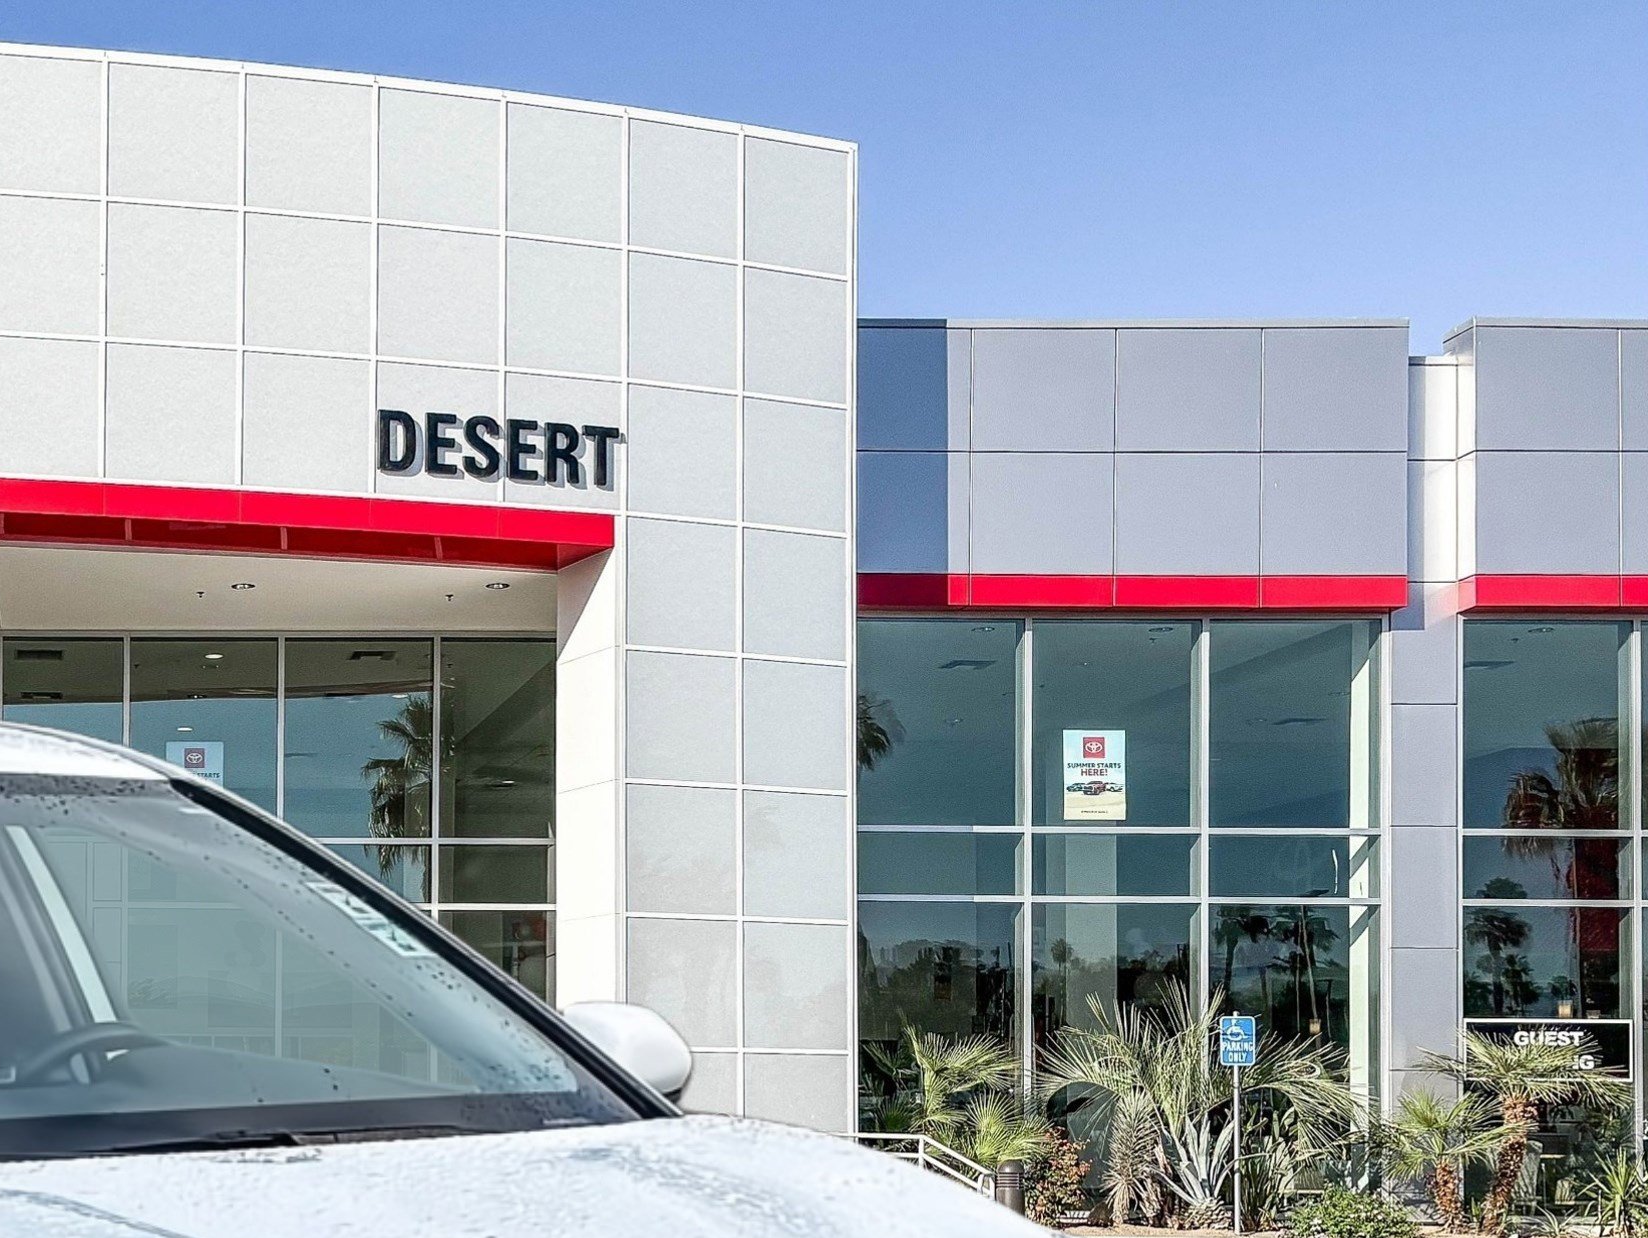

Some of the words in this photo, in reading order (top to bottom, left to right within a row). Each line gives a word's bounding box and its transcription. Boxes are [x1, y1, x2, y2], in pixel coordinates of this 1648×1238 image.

[377, 409, 620, 486] DESERT
[1081, 769, 1108, 777] HERE!
[1513, 1030, 1584, 1047] GUEST
[1222, 1041, 1253, 1052] PARKING
[1228, 1052, 1247, 1062] ONLY
